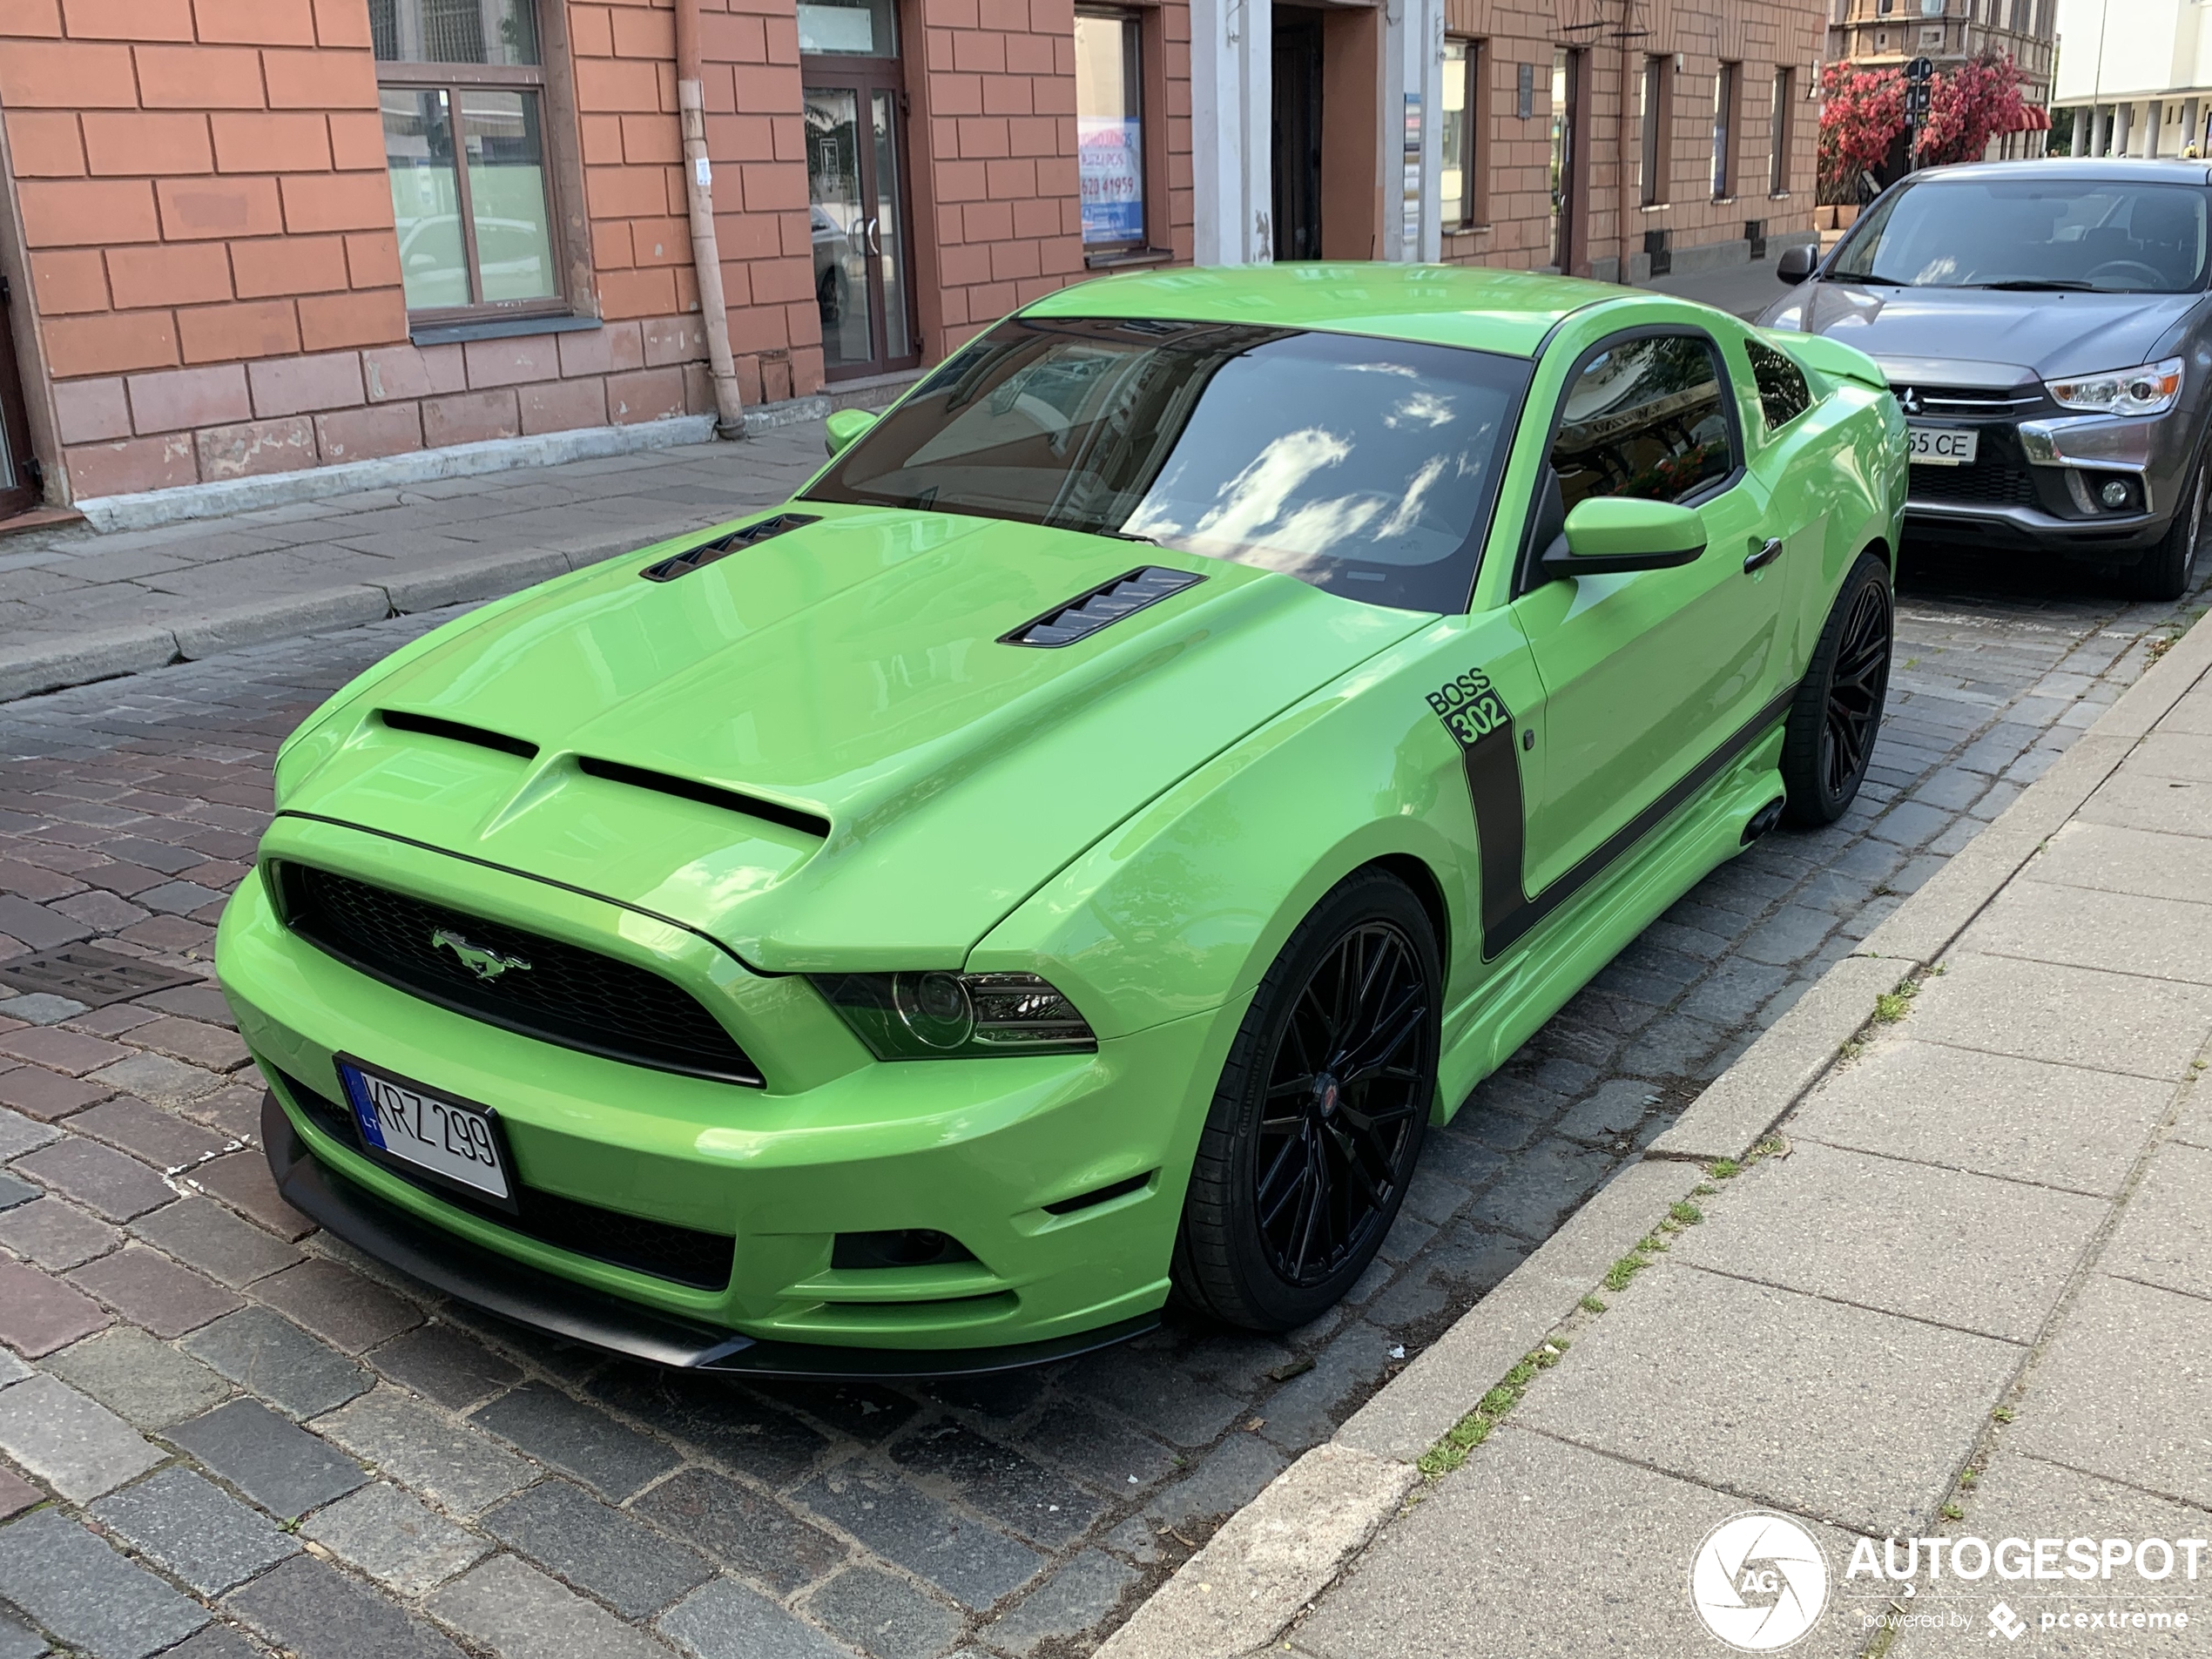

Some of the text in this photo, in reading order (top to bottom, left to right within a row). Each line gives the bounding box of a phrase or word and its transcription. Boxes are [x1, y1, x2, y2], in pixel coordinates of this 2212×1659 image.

[1936, 435, 1968, 456] CE
[1425, 667, 1490, 717] BOSS
[1451, 697, 1507, 743] 302
[361, 1115, 377, 1130] LT
[363, 1076, 496, 1168] KRZ 299
